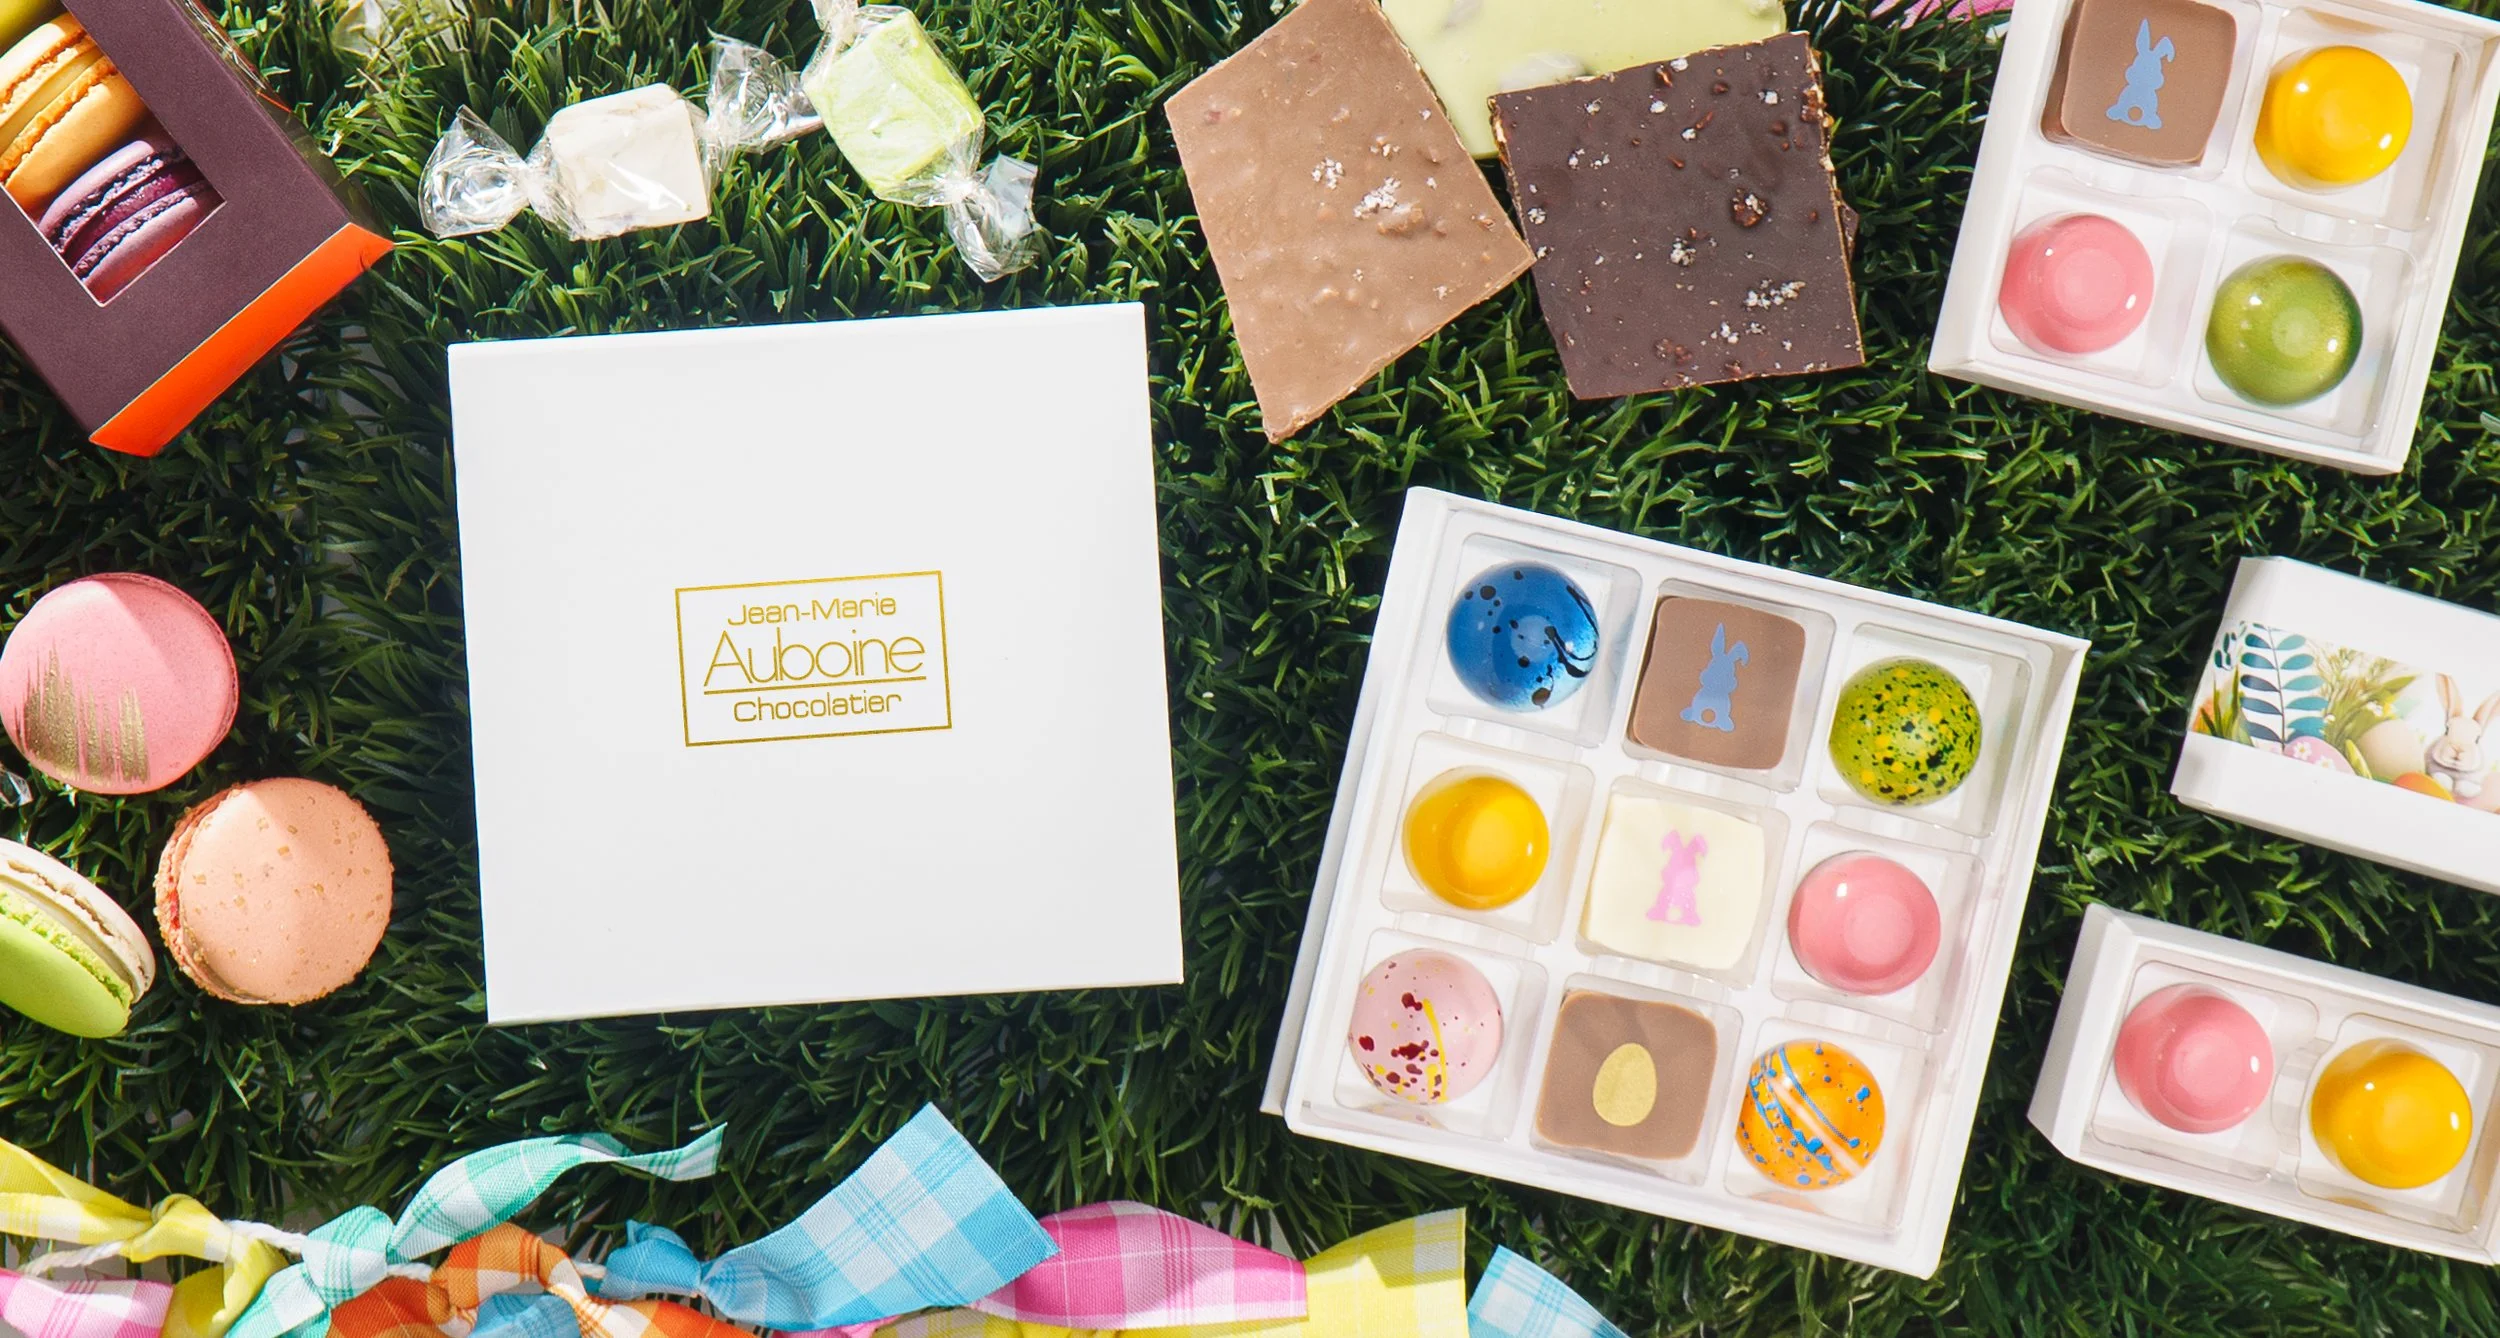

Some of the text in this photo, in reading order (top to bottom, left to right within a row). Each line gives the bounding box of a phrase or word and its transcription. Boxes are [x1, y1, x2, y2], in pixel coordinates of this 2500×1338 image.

[727, 592, 897, 626] Jean-Marie
[703, 626, 926, 687] Auboine
[733, 690, 902, 722] Chocolatier
